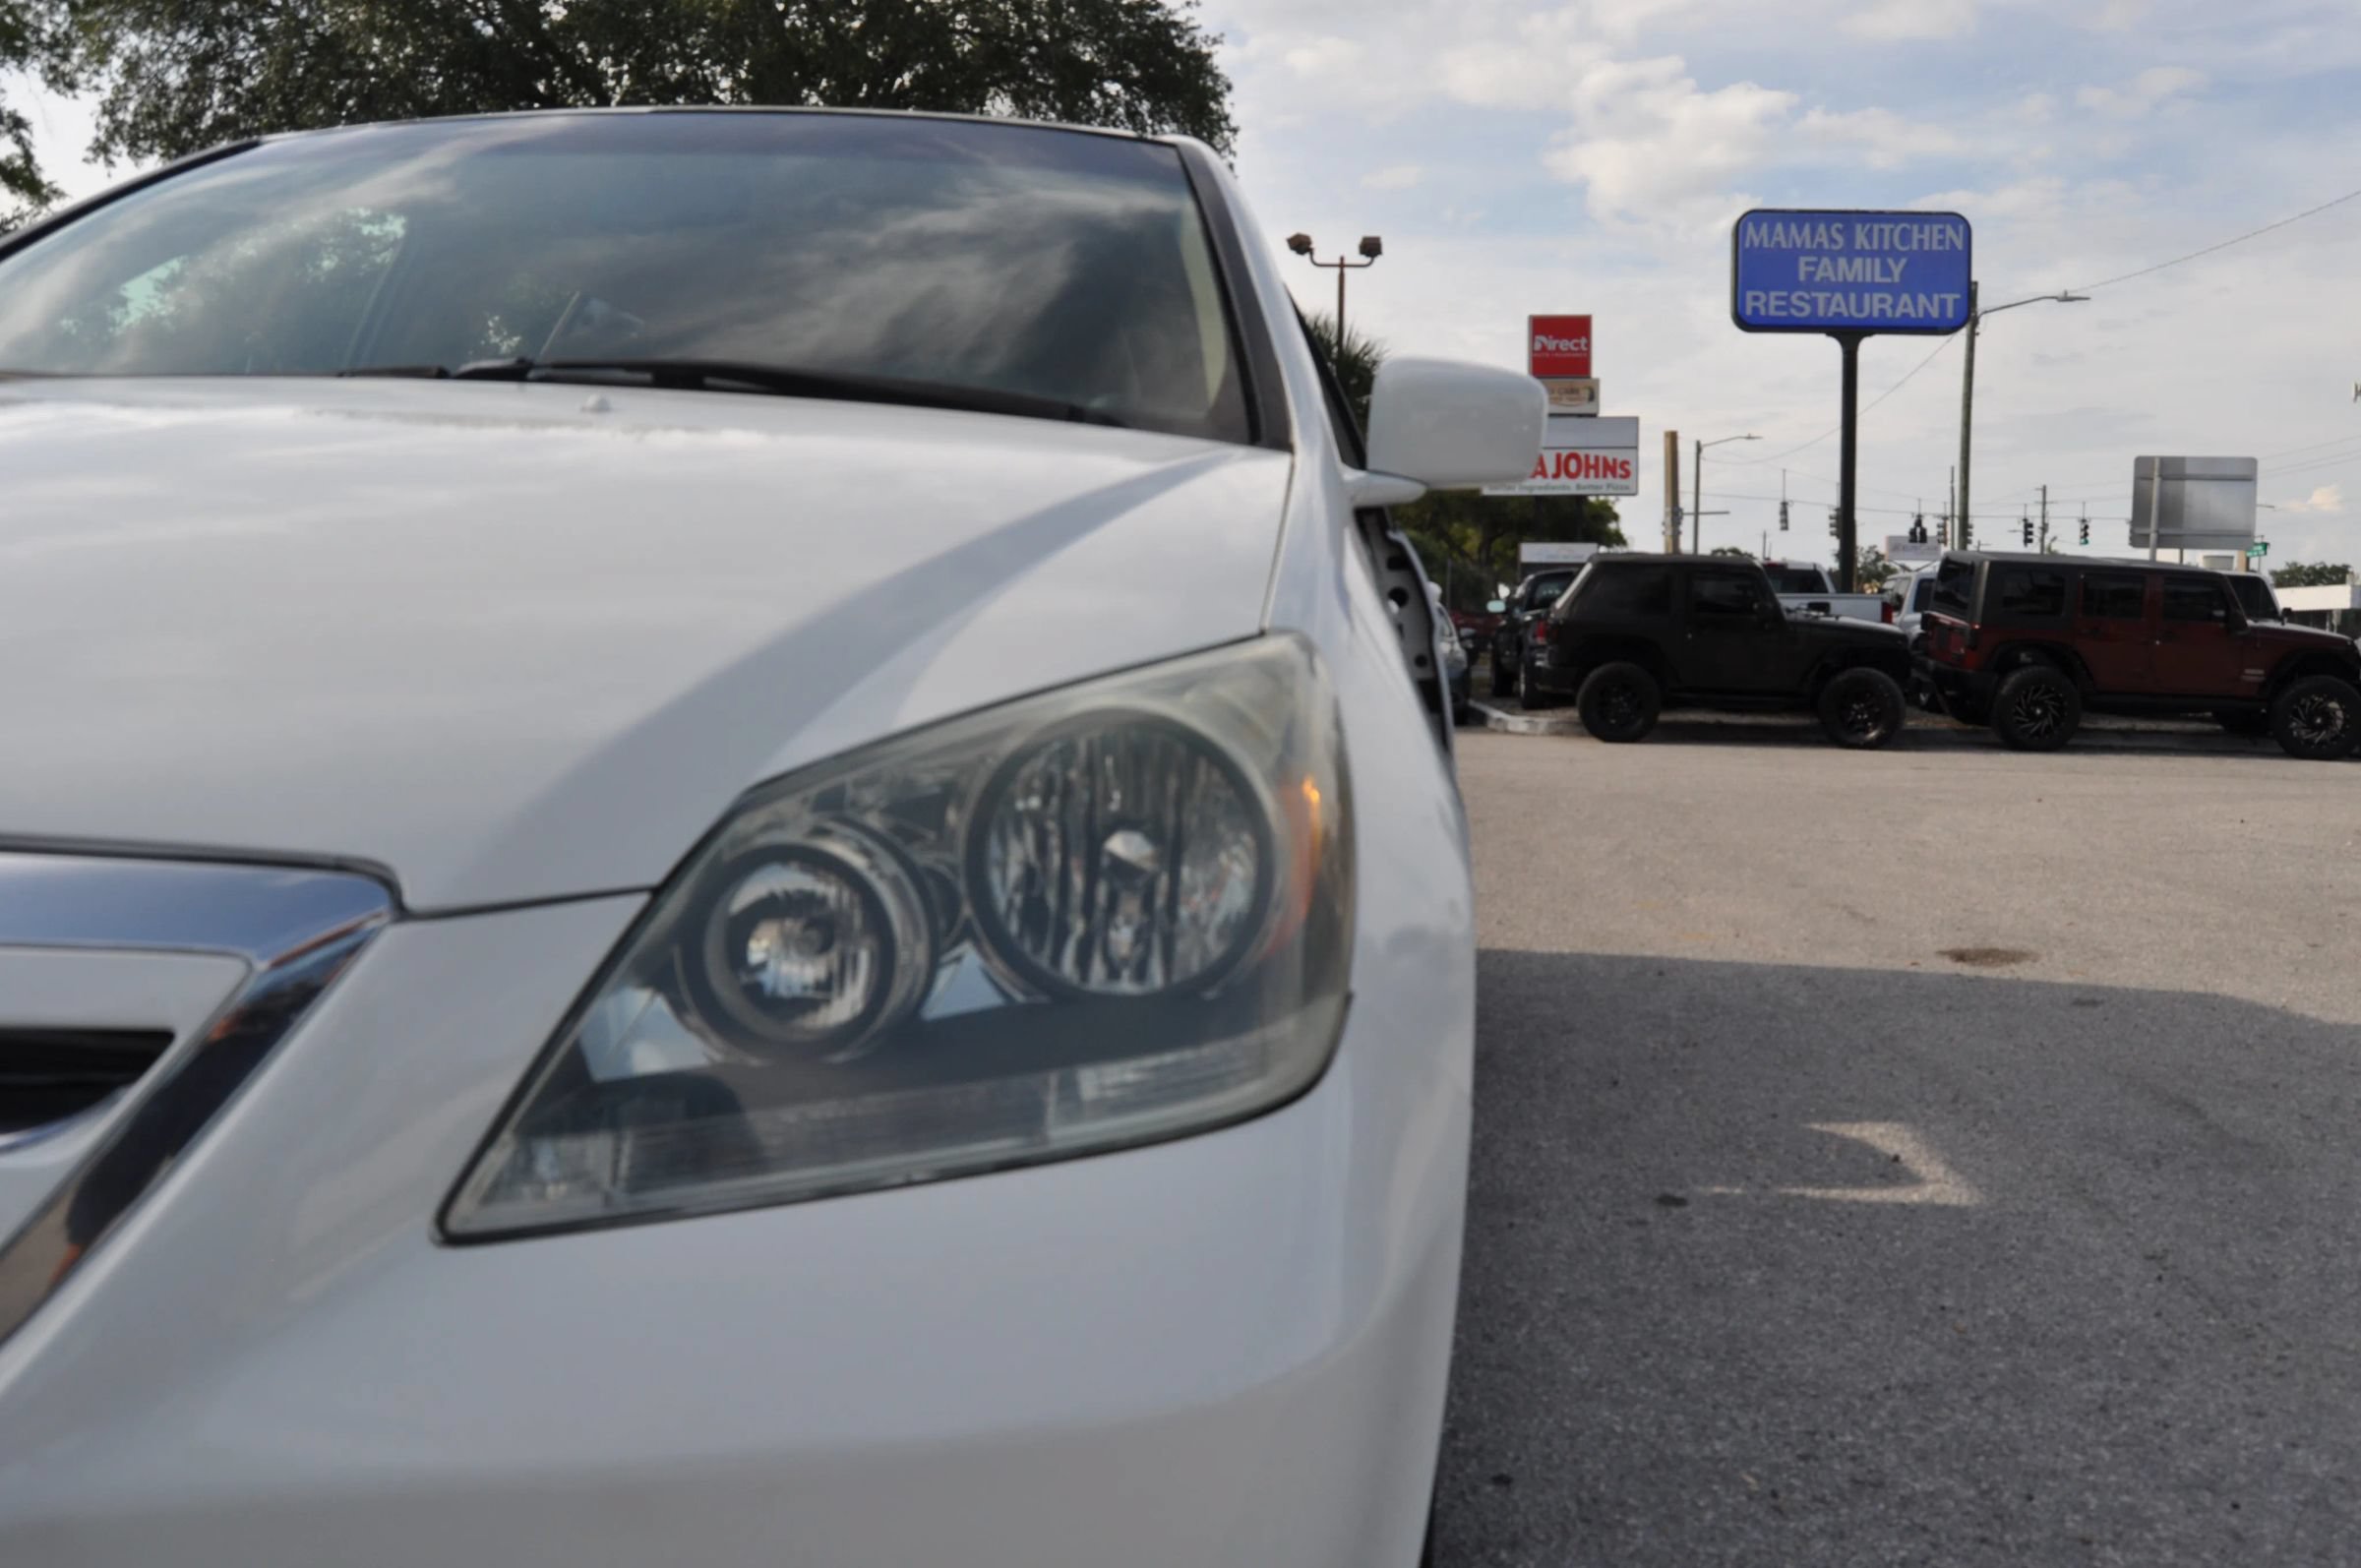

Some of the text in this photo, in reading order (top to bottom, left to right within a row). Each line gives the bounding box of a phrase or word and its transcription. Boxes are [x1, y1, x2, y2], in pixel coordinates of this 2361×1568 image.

[1744, 222, 1964, 252] MAMAS KITCHEN
[1798, 257, 1907, 283] FAMILY
[1745, 290, 1961, 319] RESTAURANT
[1533, 334, 1588, 351] Direct
